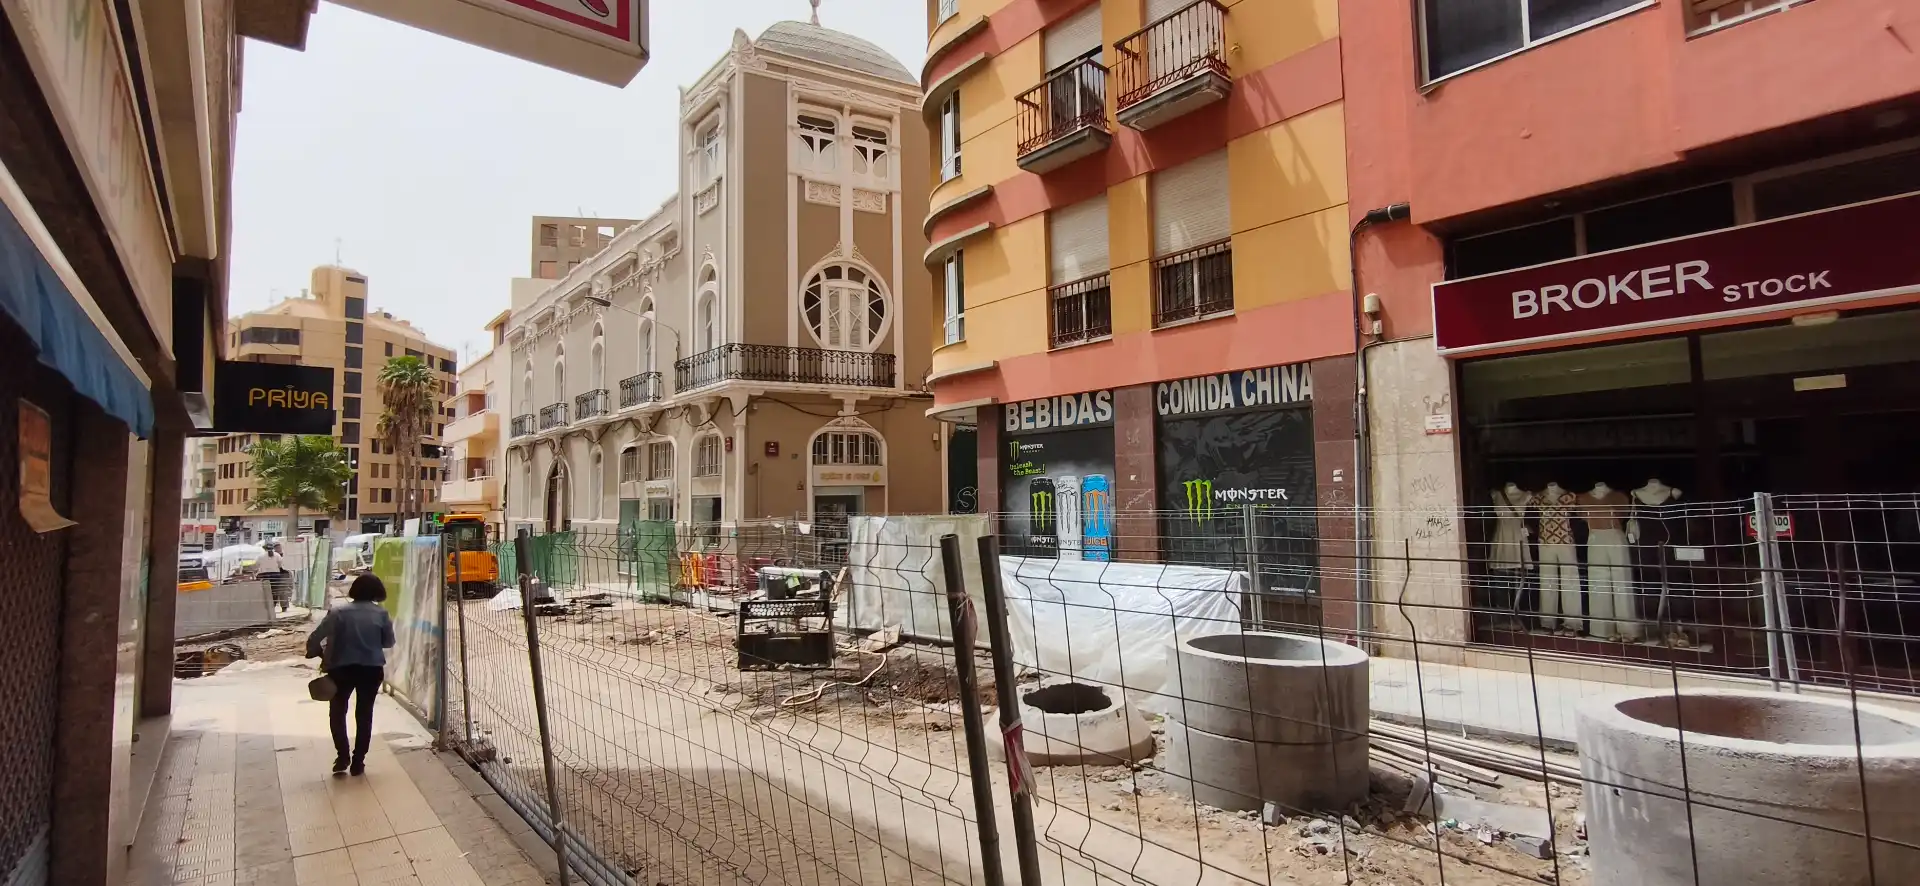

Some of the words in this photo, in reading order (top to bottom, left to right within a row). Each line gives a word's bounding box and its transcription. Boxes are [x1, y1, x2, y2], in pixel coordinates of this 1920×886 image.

[1512, 259, 1715, 320] BROKER
[1722, 269, 1832, 302] STOCK
[1005, 390, 1113, 432] BEBIDAS
[1156, 373, 1235, 416] COMIDA
[1240, 362, 1314, 406] CHINA
[1214, 487, 1288, 502] MONSTER
